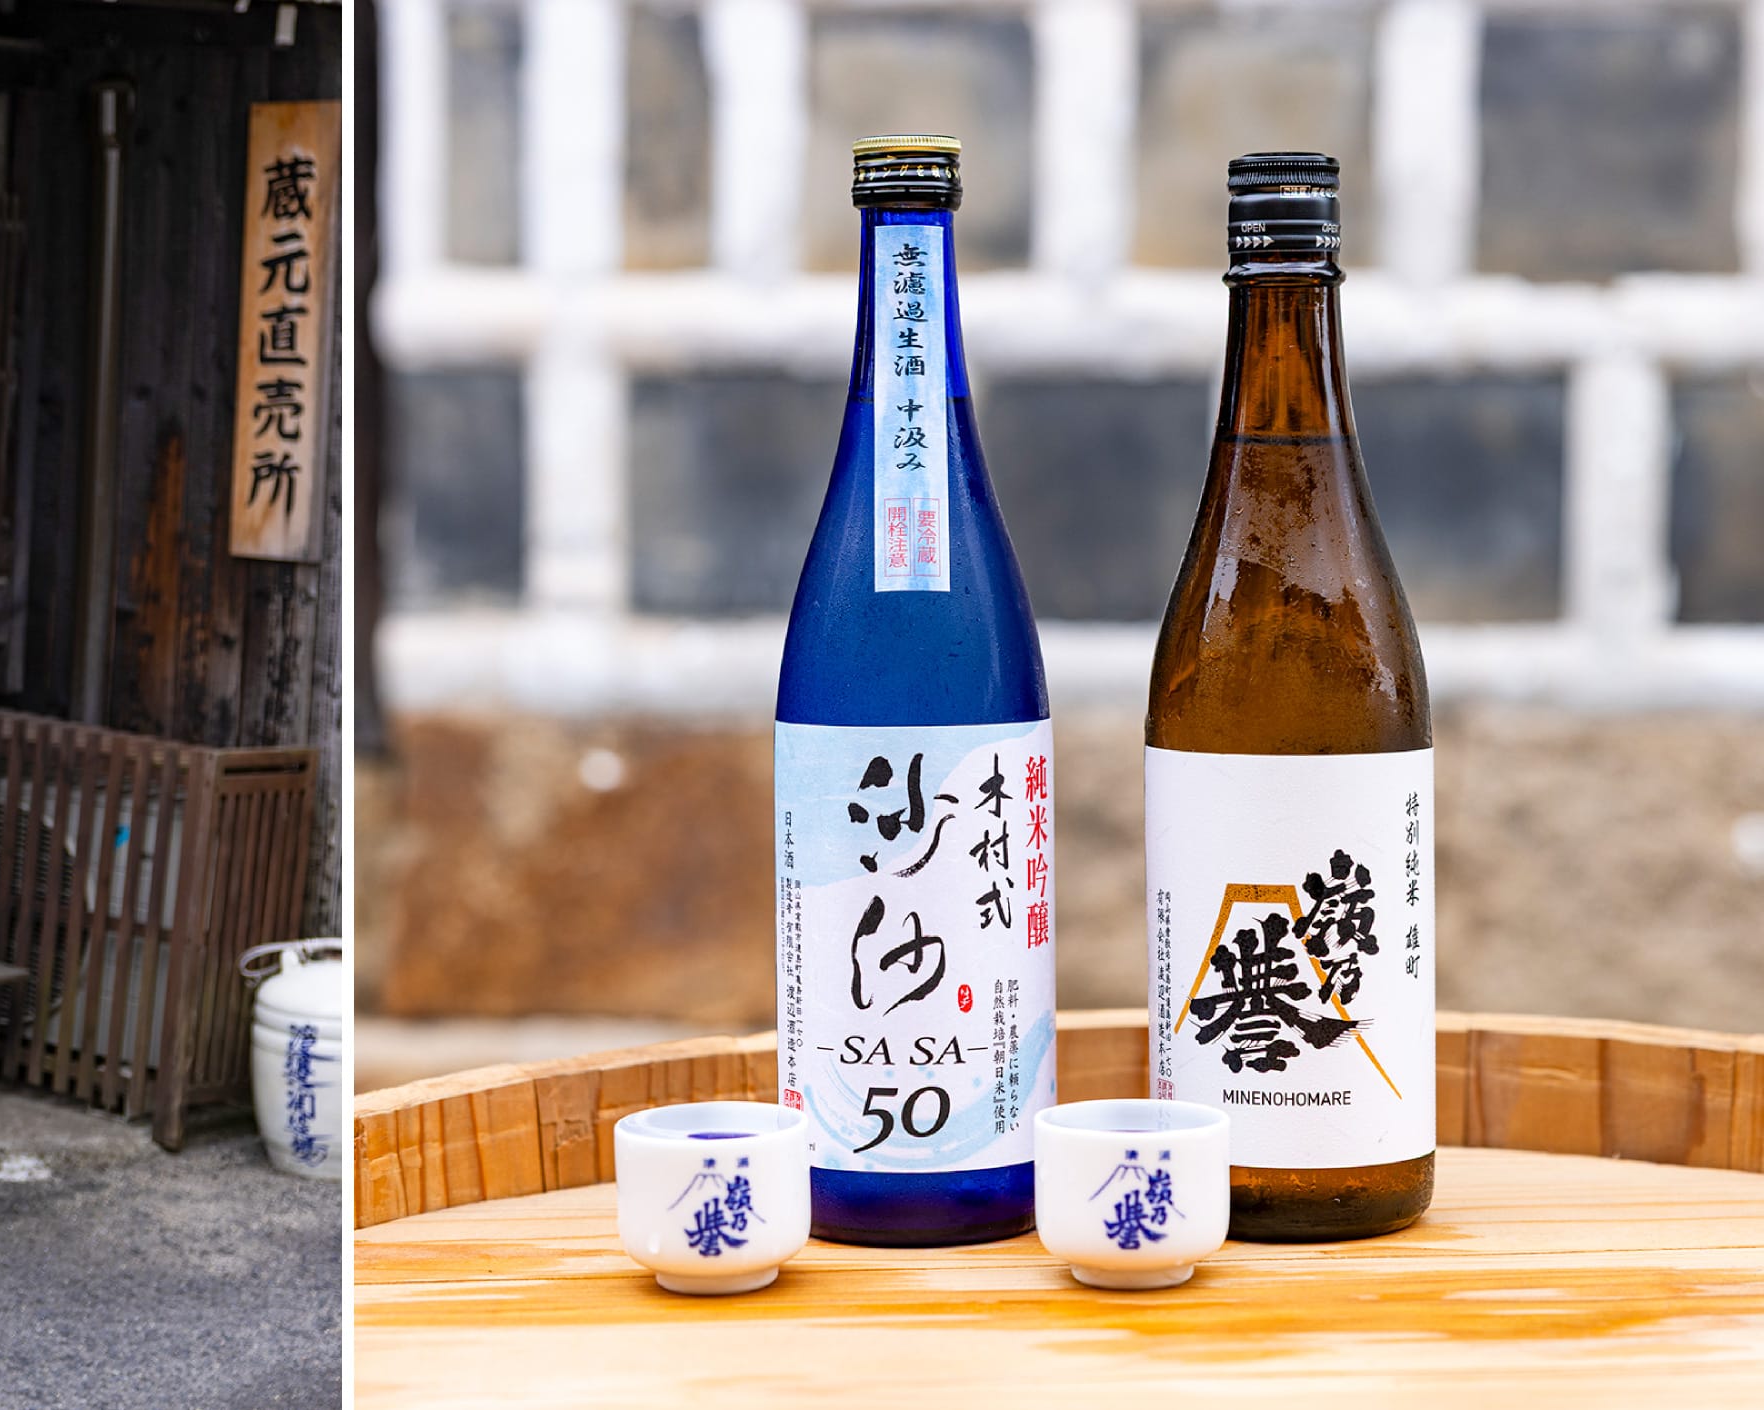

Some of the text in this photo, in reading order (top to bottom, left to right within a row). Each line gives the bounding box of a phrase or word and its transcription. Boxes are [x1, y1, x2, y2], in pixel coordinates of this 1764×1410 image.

[1241, 223, 1266, 233] OPEN
[247, 155, 316, 517] 蔵元直売所
[892, 243, 929, 471] 無濾過生酒 中汲み
[887, 506, 908, 568] 開栓注意
[917, 510, 937, 565] 要冷蔵
[784, 810, 795, 870] 日本酒
[969, 753, 1014, 929] 木村式
[1025, 754, 1050, 950] 純米吟醸
[1405, 791, 1421, 979] 特別純米 雄町
[853, 1086, 952, 1155] 50
[1222, 1089, 1352, 1107] MINENOHOMARE
